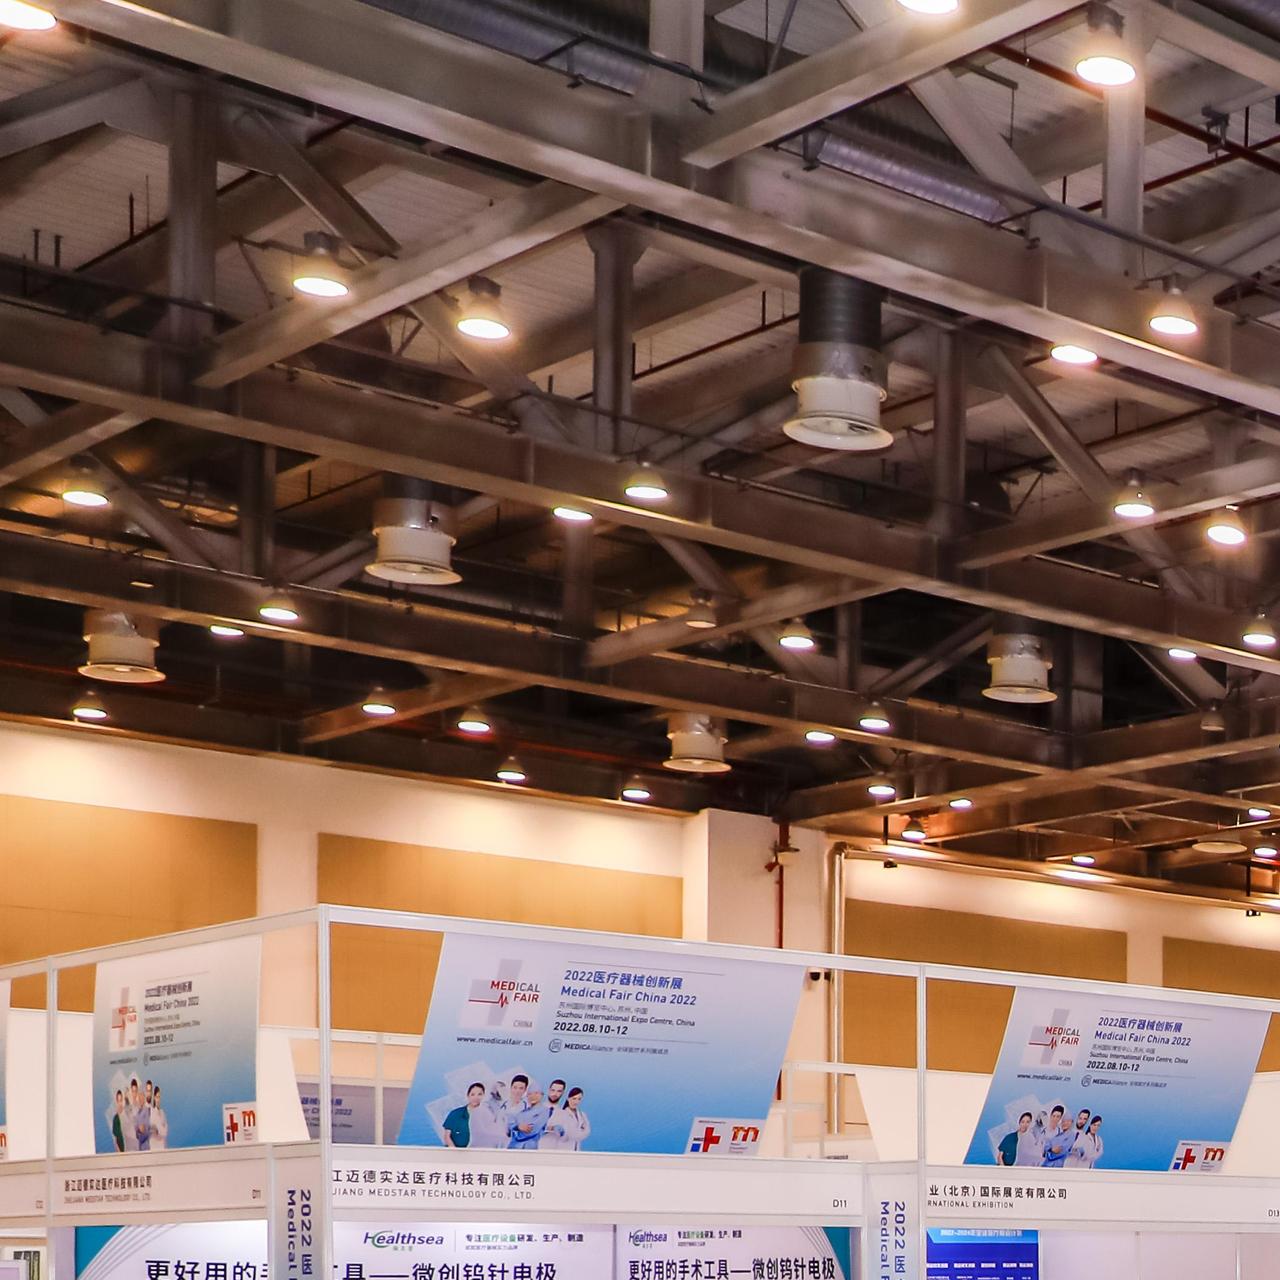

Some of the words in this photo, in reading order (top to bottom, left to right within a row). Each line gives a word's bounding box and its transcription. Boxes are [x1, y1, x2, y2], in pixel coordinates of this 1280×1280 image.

[490, 980, 540, 993] MEDICAL
[564, 970, 683, 990] 2022医疗器械创新展
[514, 993, 539, 1004] FAIR
[561, 986, 606, 998] Medical
[610, 989, 631, 1000] Fair
[635, 991, 667, 1003] China
[670, 995, 697, 1006] 2022
[556, 1011, 583, 1020] Suzhou
[584, 1012, 630, 1023] International
[631, 1016, 648, 1025] Expo
[553, 1021, 628, 1035] 2022.08.10-12
[1045, 1026, 1080, 1036] MEDICAL
[1061, 1037, 1079, 1046] FAIR
[1095, 1031, 1127, 1041] Medical
[1129, 1033, 1144, 1043] Fair
[1147, 1035, 1170, 1045] China
[1172, 1037, 1191, 1046] 2022
[1086, 1061, 1140, 1072] 2022.08.10-12
[369, 1189, 417, 1197] MEDSTAR
[422, 1189, 486, 1199] TECHNOLOGY
[515, 1191, 535, 1200] LTD.
[833, 1200, 847, 1208] D11
[300, 1190, 312, 1247] 2022
[1268, 1209, 1280, 1217] D13
[288, 1190, 297, 1271] Medical
[895, 1202, 906, 1250] 2022
[363, 1230, 444, 1248] Healthsea
[880, 1201, 890, 1270] Medical
